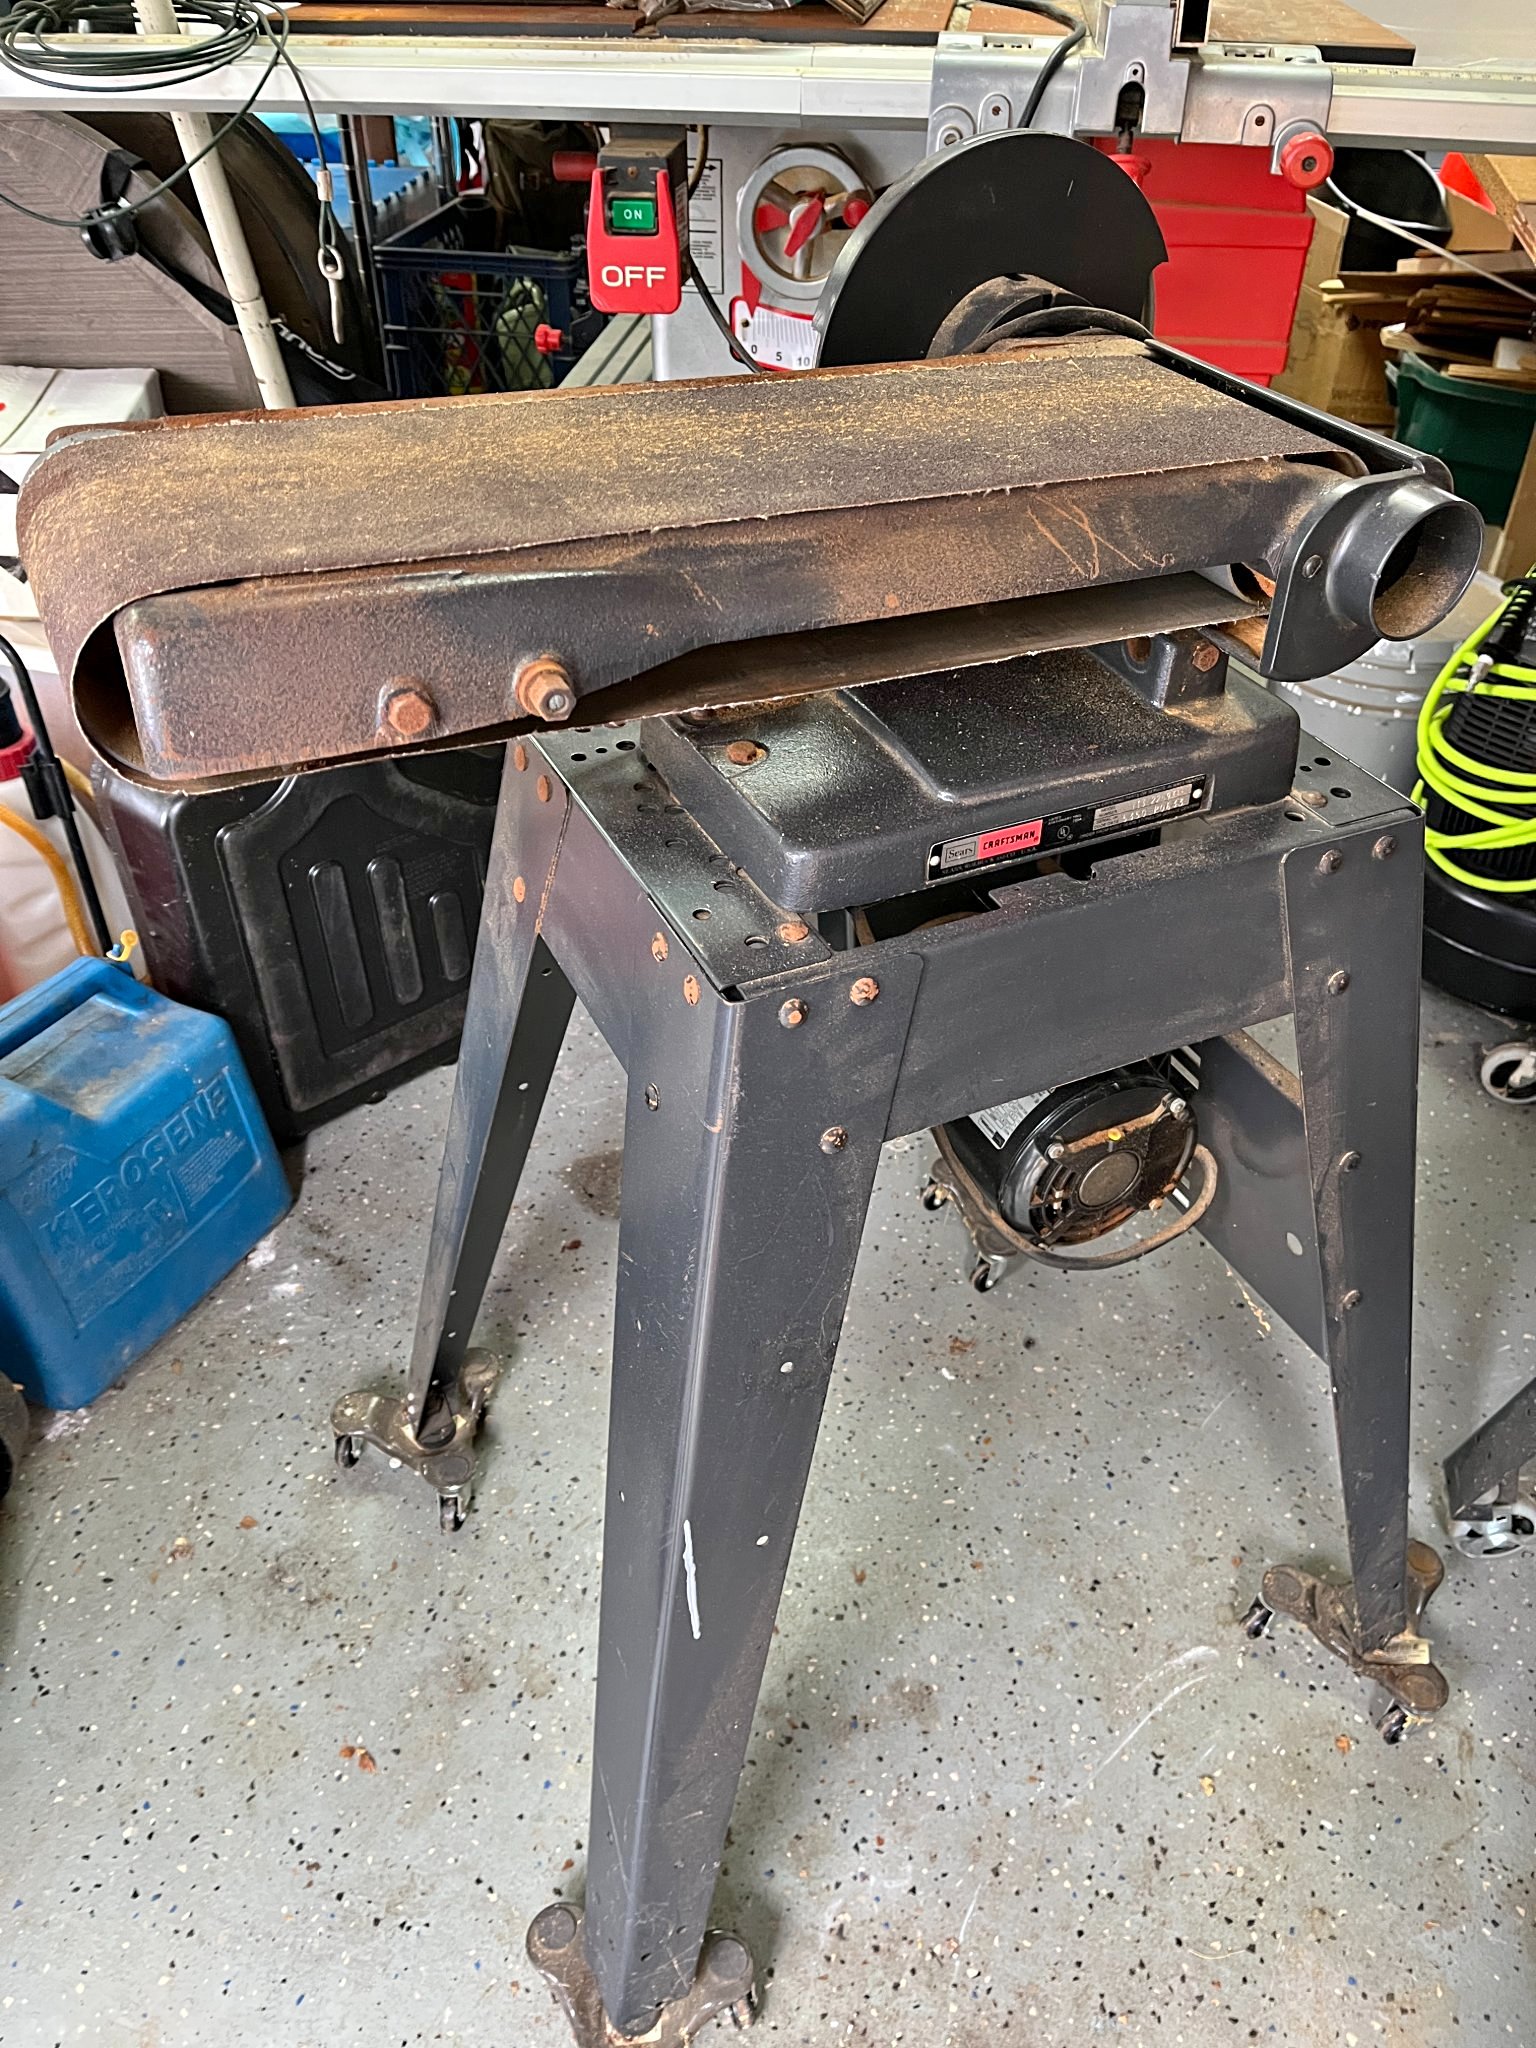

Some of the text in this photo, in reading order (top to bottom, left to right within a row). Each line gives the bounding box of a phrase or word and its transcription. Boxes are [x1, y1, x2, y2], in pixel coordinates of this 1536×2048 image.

[623, 208, 643, 220] ON
[601, 265, 667, 288] OFF
[751, 344, 810, 367] 0 5 10
[947, 830, 1036, 860] Sears CRAFTSMAN
[39, 1078, 229, 1253] KEROSENE
